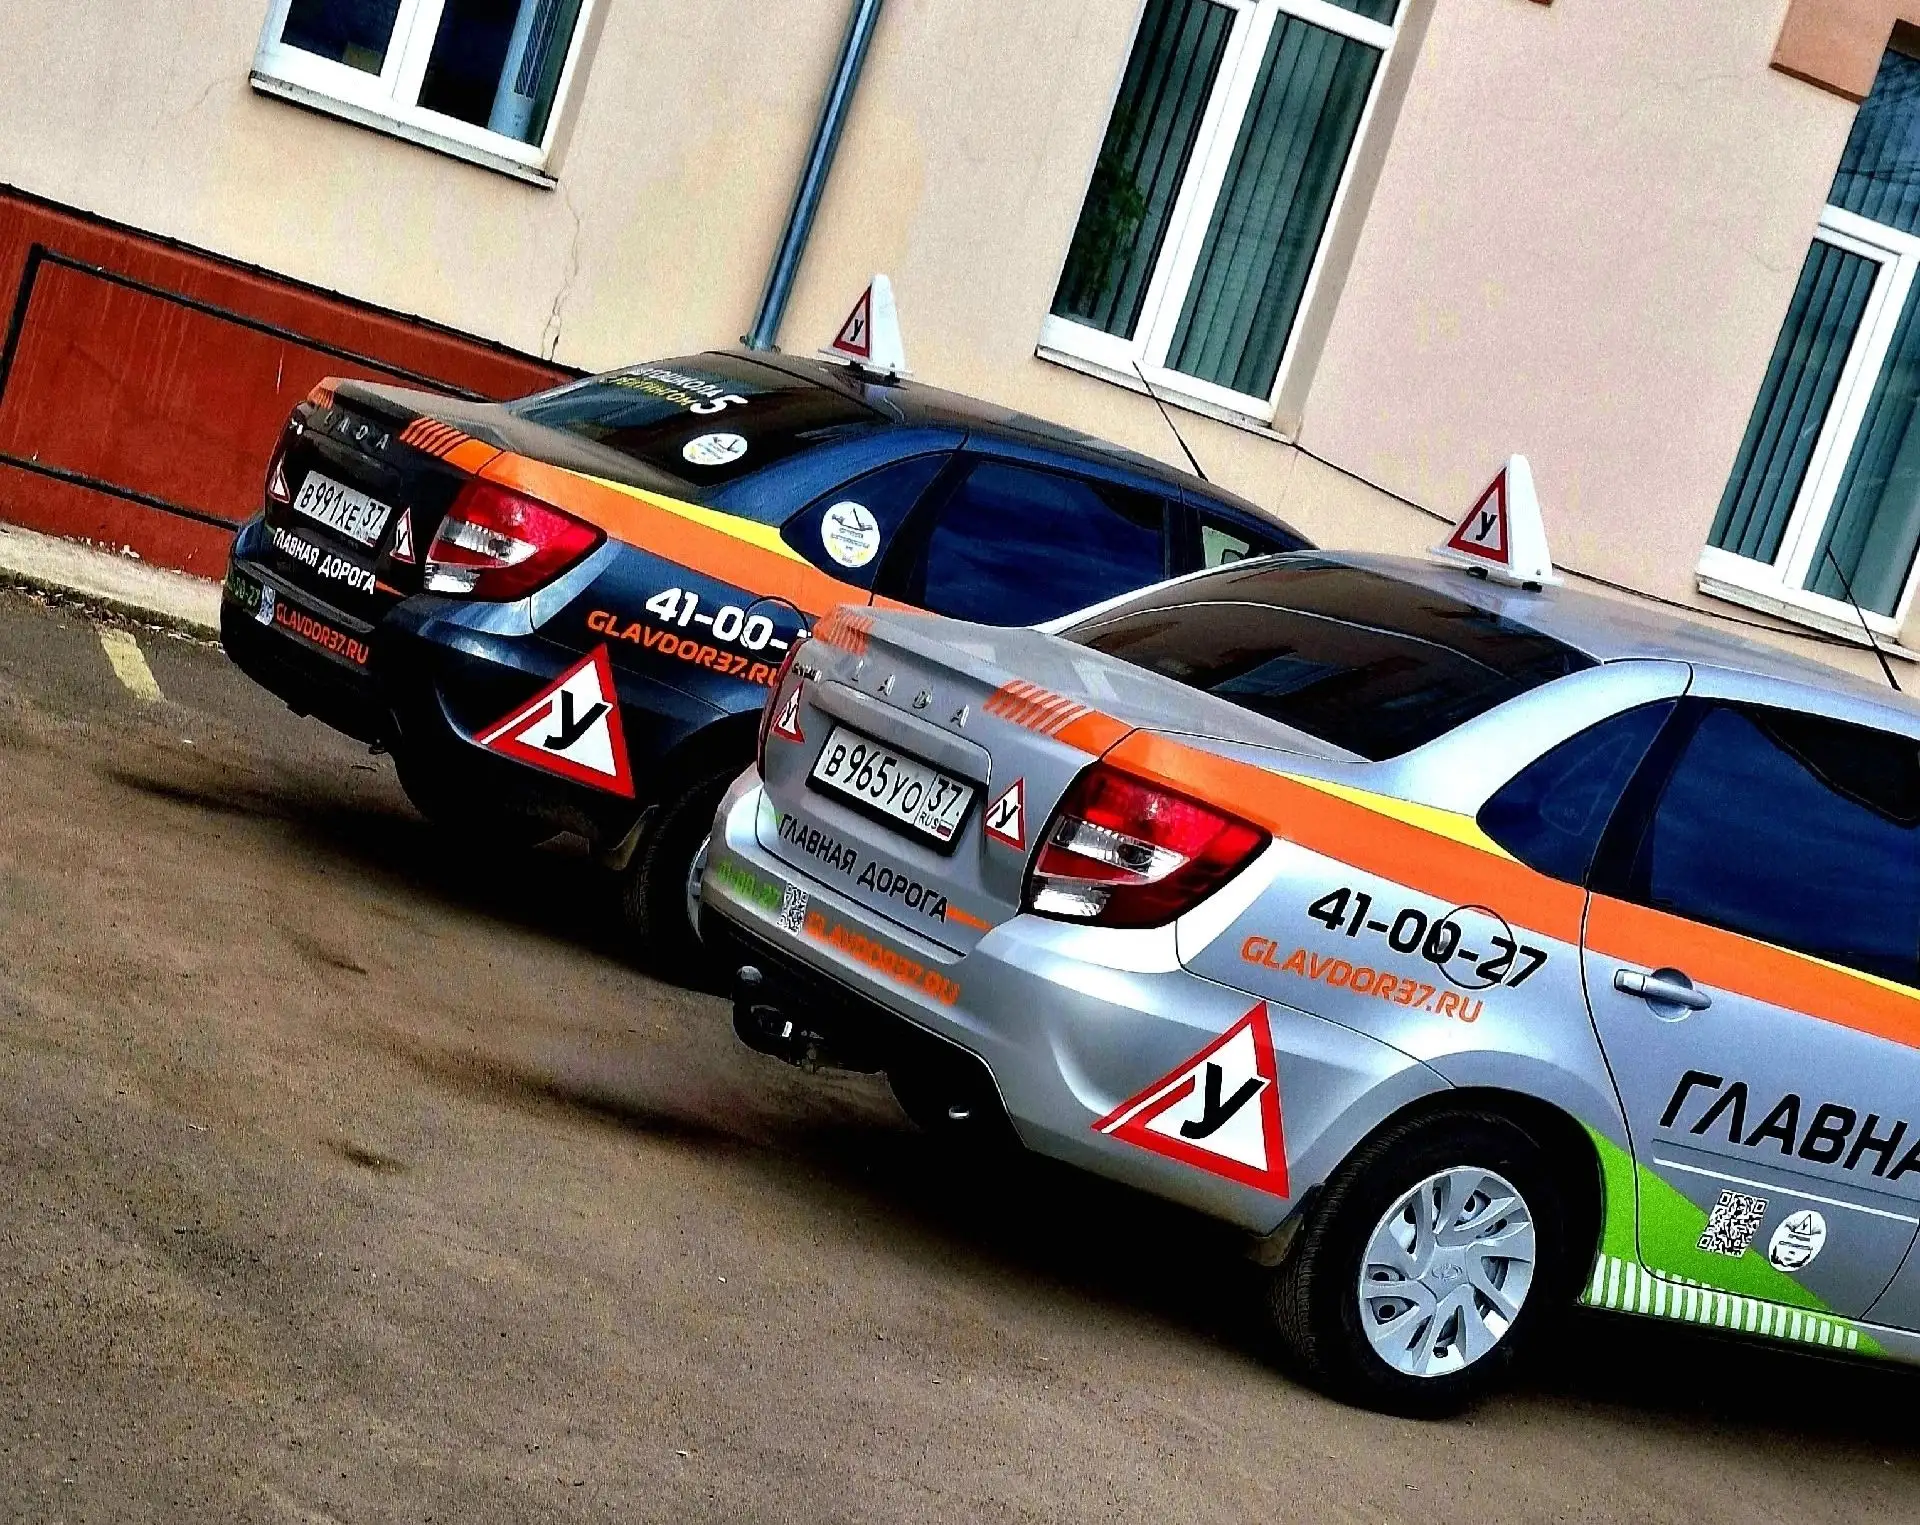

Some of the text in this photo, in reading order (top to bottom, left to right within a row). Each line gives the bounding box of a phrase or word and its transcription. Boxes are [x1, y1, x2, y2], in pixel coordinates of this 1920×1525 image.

[850, 319, 864, 341] У
[690, 395, 748, 414] 5
[1476, 510, 1498, 541] У
[272, 528, 376, 594] ГЛАВНАЯ ДОРОГА
[276, 602, 370, 664] GLAVDOR37.RU
[645, 587, 812, 651] 41-00-
[543, 690, 609, 750] У
[918, 811, 939, 830] RUS
[927, 777, 963, 820] 37
[996, 799, 1018, 828] У
[780, 814, 948, 923] ГЛАВНАЯ ДОРОГА
[1308, 887, 1548, 988] 41-00-27
[1241, 935, 1484, 1023] GLAVDOR37.RU
[1179, 1062, 1265, 1140] У
